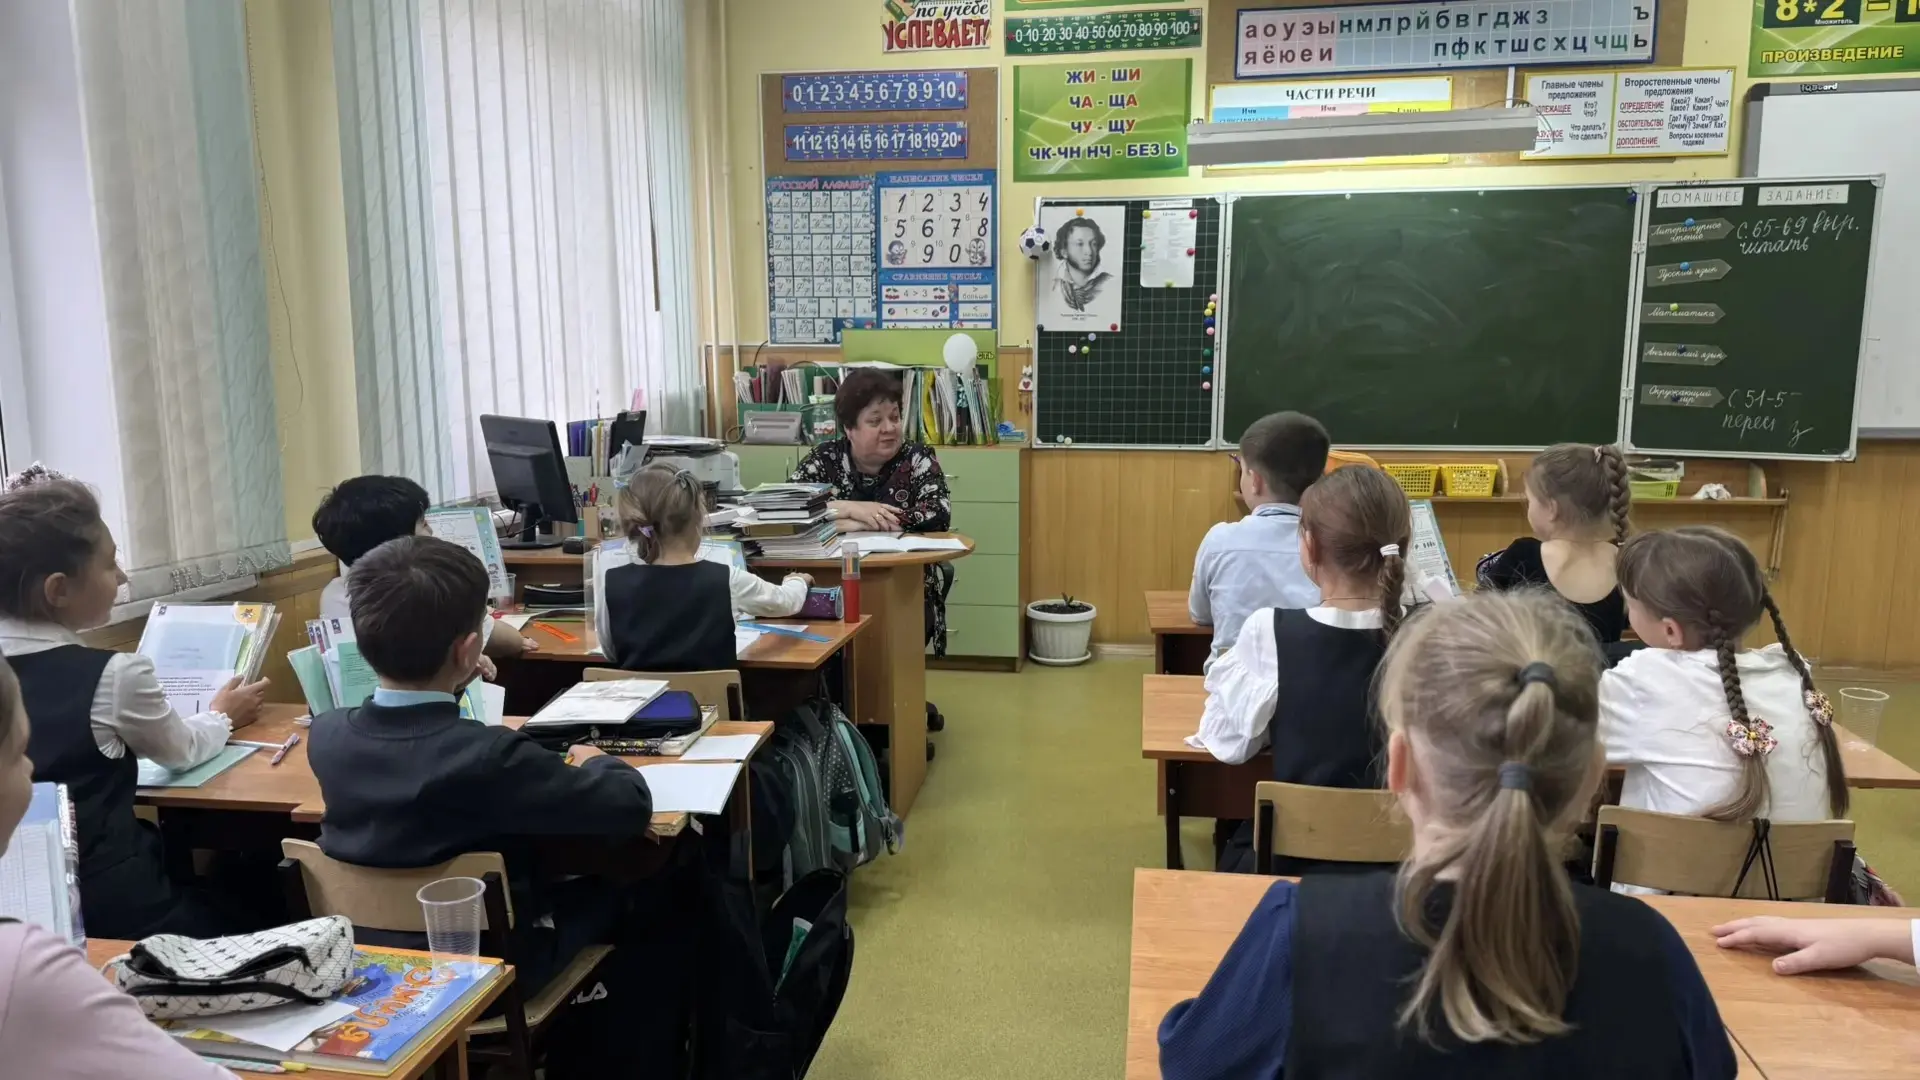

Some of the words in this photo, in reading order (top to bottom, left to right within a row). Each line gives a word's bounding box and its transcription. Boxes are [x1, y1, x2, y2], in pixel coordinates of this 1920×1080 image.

[916, 7, 938, 18] по
[944, 1, 989, 20] учёбе
[882, 18, 990, 50] УСПЕВАЕТ!
[1015, 29, 1023, 43] 0
[1026, 29, 1039, 42] 10
[1042, 28, 1056, 41] 20
[1059, 27, 1072, 41] 30
[1075, 26, 1089, 39] 40
[1092, 25, 1105, 39] 50
[1107, 24, 1121, 38] 60
[1123, 23, 1136, 37] 70
[1138, 23, 1152, 37] 80
[1154, 22, 1168, 36] 90
[1170, 21, 1190, 35] 100
[1761, 46, 1904, 63] ПРОИЗВЕДЕНИЕ
[1066, 71, 1095, 83] ЖИ
[1112, 69, 1141, 82] ШИ
[1625, 78, 1692, 88] Второстепенные
[1694, 77, 1721, 85] члены
[793, 85, 801, 102] 0
[806, 85, 814, 101] 1
[820, 85, 830, 101] 2
[835, 84, 844, 101] 3
[850, 84, 859, 100] 4
[865, 83, 874, 100] 5
[879, 83, 889, 100] 6
[893, 83, 902, 99] 7
[908, 82, 917, 99] 8
[923, 81, 932, 99] 9
[937, 81, 956, 98] 10
[1541, 80, 1576, 90] Главные
[1578, 79, 1604, 88] члены
[1286, 88, 1334, 101] ЧАСТИ
[1339, 87, 1376, 99] РЕЧИ
[1548, 91, 1596, 100] предложения
[1644, 87, 1693, 97] предложения
[1070, 96, 1093, 108] ЧА
[1109, 94, 1138, 109] ЩА
[1584, 101, 1598, 109] Кто?
[1620, 101, 1664, 110] ОПРЕДЕЛЕНИЕ
[1071, 121, 1093, 133] ЧУ
[1108, 119, 1135, 134] ЩУ
[1582, 123, 1606, 132] делать?
[1617, 119, 1664, 128] ОБСТОЯТЕЛЬСТВО
[793, 135, 806, 150] 11
[808, 135, 822, 150] 12
[824, 134, 839, 150] 13
[841, 134, 856, 149] 14
[858, 133, 872, 149] 15
[874, 133, 889, 149] 16
[891, 133, 905, 148] 17
[908, 133, 922, 148] 18
[925, 132, 939, 148] 19
[941, 132, 958, 148] 20
[1580, 132, 1608, 141] сделать?
[1616, 137, 1658, 146] ДОПОЛНЕНИЕ
[1669, 132, 1693, 140] Вопросы
[1087, 145, 1111, 158] НЧ
[1126, 143, 1160, 157] БЕЗ
[898, 194, 907, 213] 1
[922, 193, 934, 212] 2
[949, 192, 961, 212] 3
[979, 192, 989, 212] 4
[1661, 190, 1740, 205] ДОМАШНЕЕ
[895, 219, 907, 238] 5
[922, 219, 934, 238] 6
[951, 218, 961, 238] 7
[978, 217, 989, 237] 8
[922, 244, 934, 263] 9
[949, 244, 961, 263] 0
